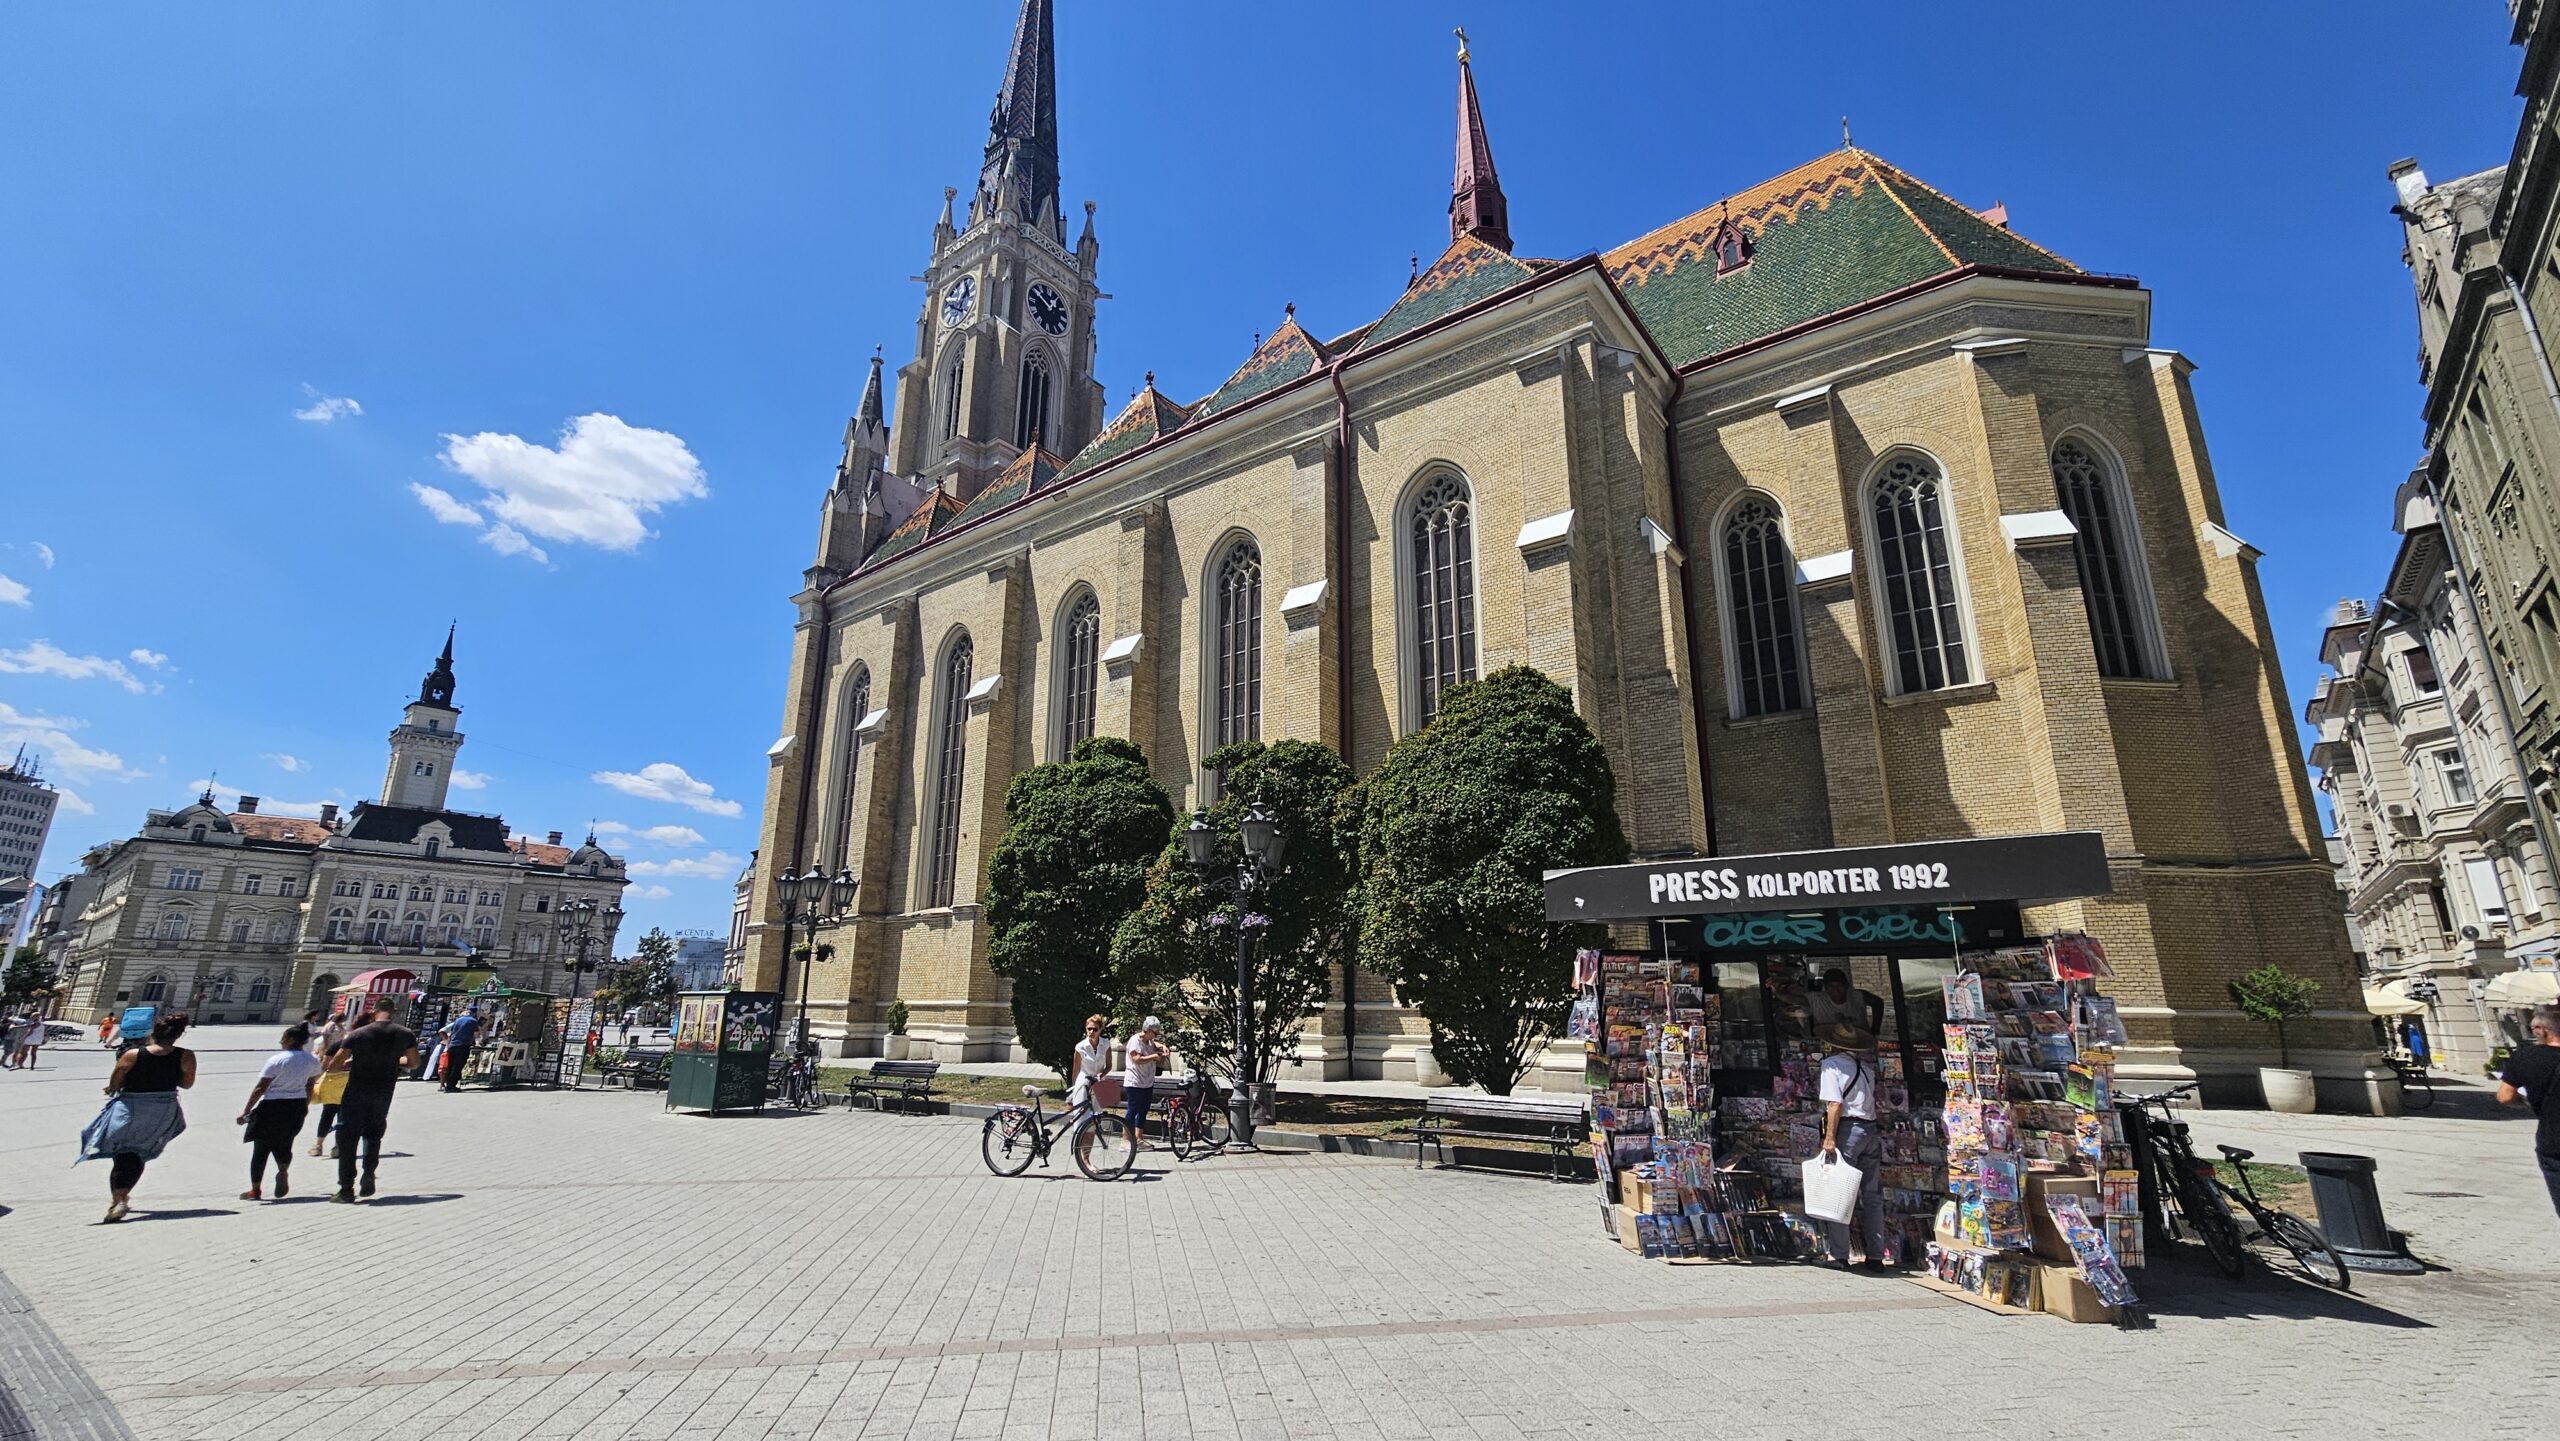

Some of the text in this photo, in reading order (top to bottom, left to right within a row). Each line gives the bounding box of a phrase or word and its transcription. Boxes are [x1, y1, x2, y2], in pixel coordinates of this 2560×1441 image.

[1649, 863, 1950, 904] PRESS KOLPORTER 1992
[684, 929, 715, 937] CENTAR
